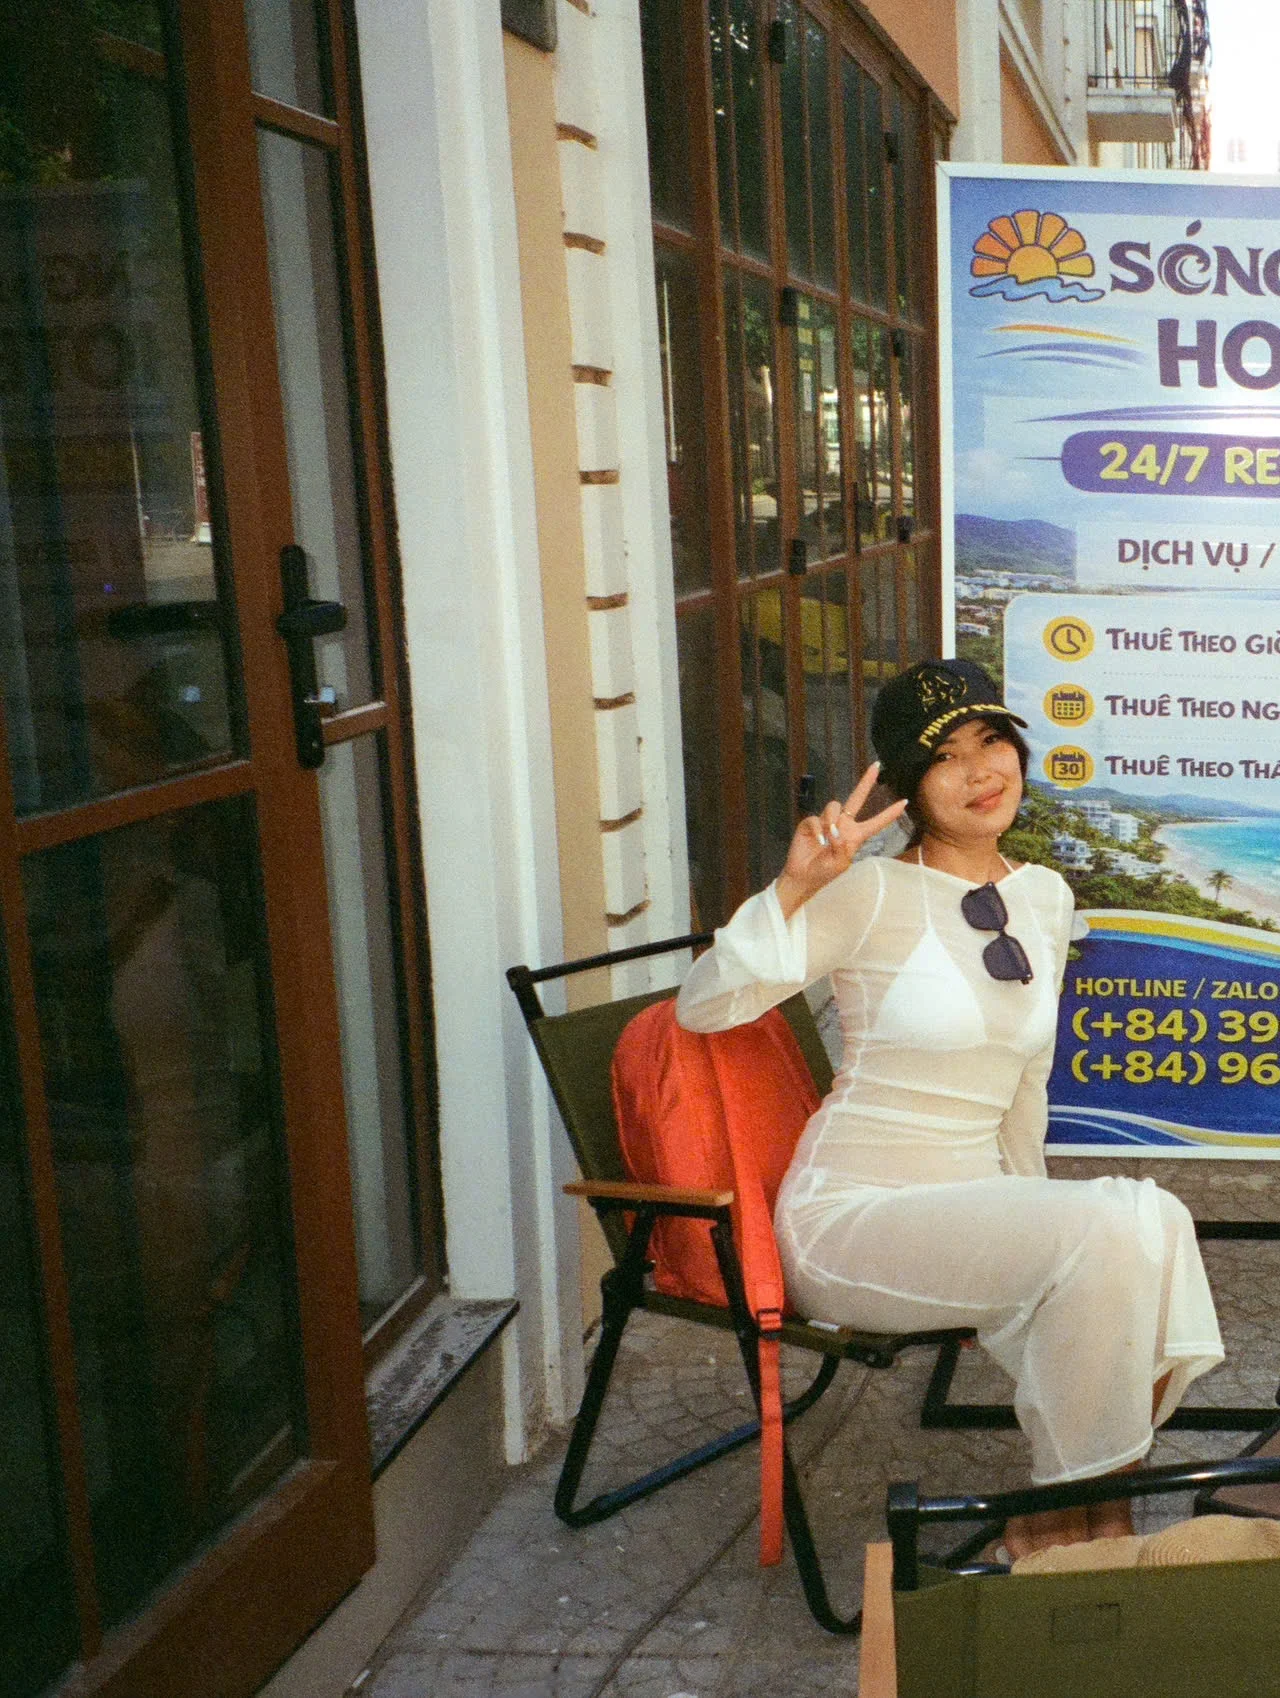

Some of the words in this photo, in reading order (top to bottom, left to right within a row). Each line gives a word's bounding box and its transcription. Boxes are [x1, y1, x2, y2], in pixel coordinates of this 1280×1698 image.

[1099, 442, 1209, 485] 24/7
[1118, 539, 1193, 570] DỊCH
[1203, 542, 1248, 573] VỤ
[1260, 543, 1275, 568] /
[1058, 762, 1079, 775] 30
[1076, 978, 1186, 997] HOTLINE
[1193, 978, 1206, 1000] /
[1211, 981, 1279, 1000] ZALO
[1073, 1008, 1207, 1043] (+84)
[1072, 1050, 1206, 1085] (+84)
[1219, 1052, 1280, 1085] 96
